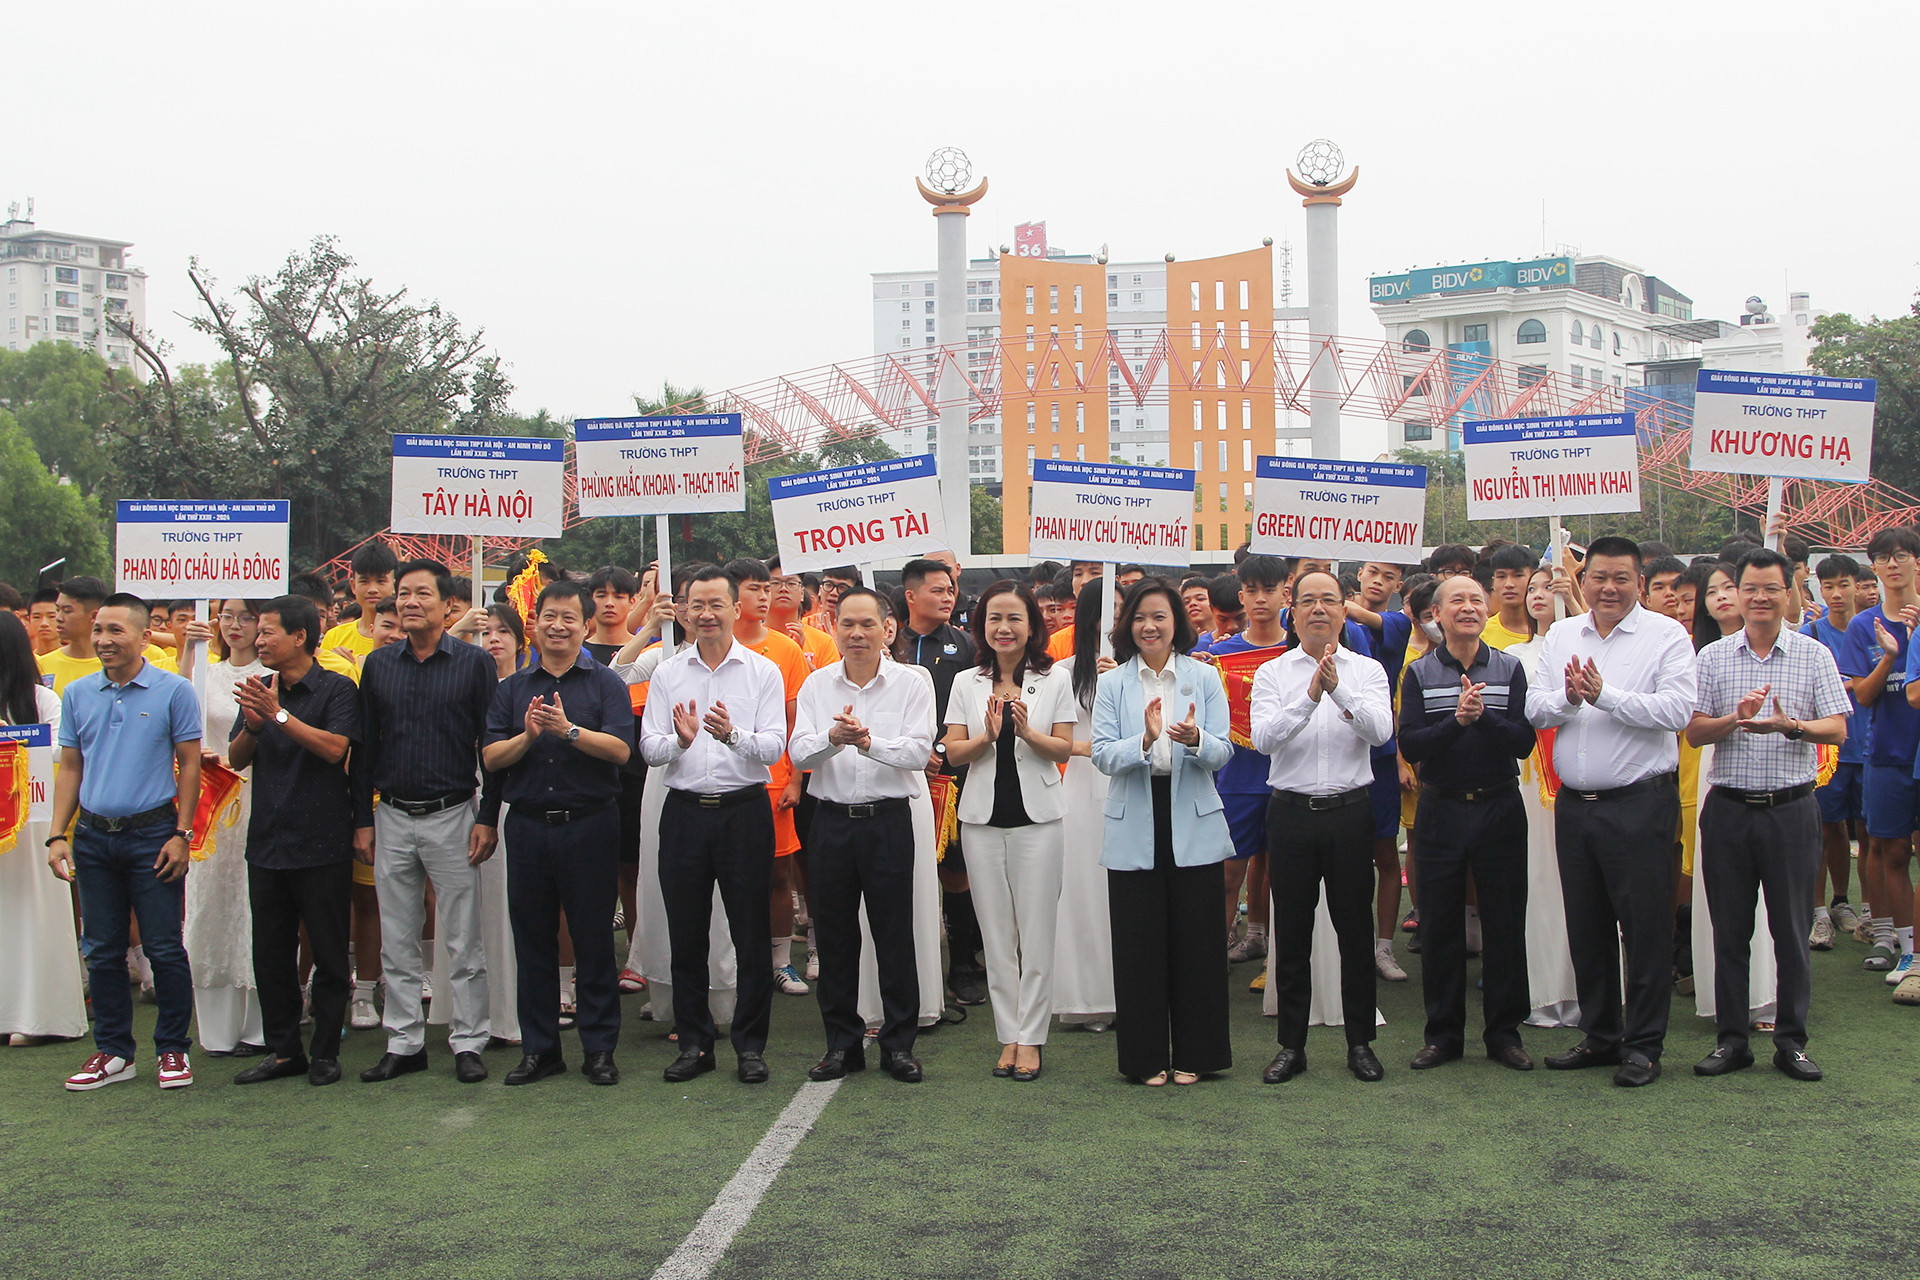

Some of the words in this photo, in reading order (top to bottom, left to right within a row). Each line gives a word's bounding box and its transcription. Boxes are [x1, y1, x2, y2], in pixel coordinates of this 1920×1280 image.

[1019, 244, 1041, 257] 36
[1432, 271, 1470, 290] BIDV
[1517, 267, 1553, 284] BIDV
[1372, 283, 1406, 298] BIDV
[1742, 404, 1792, 417] TRƯỜNG
[1796, 408, 1826, 419] THPT
[1563, 429, 1578, 437] 2024
[620, 447, 667, 459] TRƯỜNG
[670, 447, 698, 457] THPT
[1510, 448, 1559, 461] TRƯỜNG
[1562, 448, 1591, 458] THPT
[1710, 429, 1813, 458] KHƯƠNG
[1821, 436, 1851, 466] HẠ
[438, 466, 485, 479] TRƯỜNG
[489, 470, 518, 479] THPT
[829, 472, 843, 480] SINH
[843, 470, 857, 478] THPT
[1318, 464, 1332, 473] SINH
[582, 471, 614, 498] PHÙNG
[617, 466, 640, 497] KHẮC
[643, 474, 675, 495] KHOAN
[683, 473, 713, 498] THẠCH
[716, 463, 739, 493] THẤT
[866, 475, 881, 484] 2024
[1354, 475, 1368, 483] 2024
[1473, 466, 1529, 501] NGUYỄN
[1533, 475, 1555, 502] THỊ
[1559, 473, 1596, 496] MINH
[1600, 471, 1632, 494] KHAI
[422, 487, 459, 515] TÂY
[465, 489, 491, 517] HÀ
[498, 490, 532, 523] NỘI
[817, 496, 864, 512] TRƯỜNG
[868, 492, 896, 505] THPT
[1076, 493, 1121, 505] TRƯỜNG
[1125, 497, 1151, 507] THPT
[1299, 490, 1347, 503] TRƯỜNG
[1351, 494, 1379, 505] THPT
[162, 530, 209, 542] TRƯỜNG
[214, 533, 243, 542] THPT
[794, 520, 884, 553] TRỌNG
[890, 509, 929, 538] TÀI
[1035, 517, 1066, 540] PHAN
[1069, 519, 1092, 541] HUY
[1095, 515, 1118, 543] CHÚ
[1121, 522, 1156, 550] THẠCH
[1160, 516, 1187, 547] THẤT
[1257, 513, 1305, 538] GREEN
[1309, 516, 1340, 540] CITY
[1343, 519, 1417, 545] ACADEMY
[124, 559, 156, 580] PHAN
[161, 552, 181, 585] BỘI
[185, 552, 218, 580] CHÂU
[223, 552, 239, 580] HÀ
[243, 552, 280, 580] ĐÔNG
[28, 776, 45, 803] ÍN
